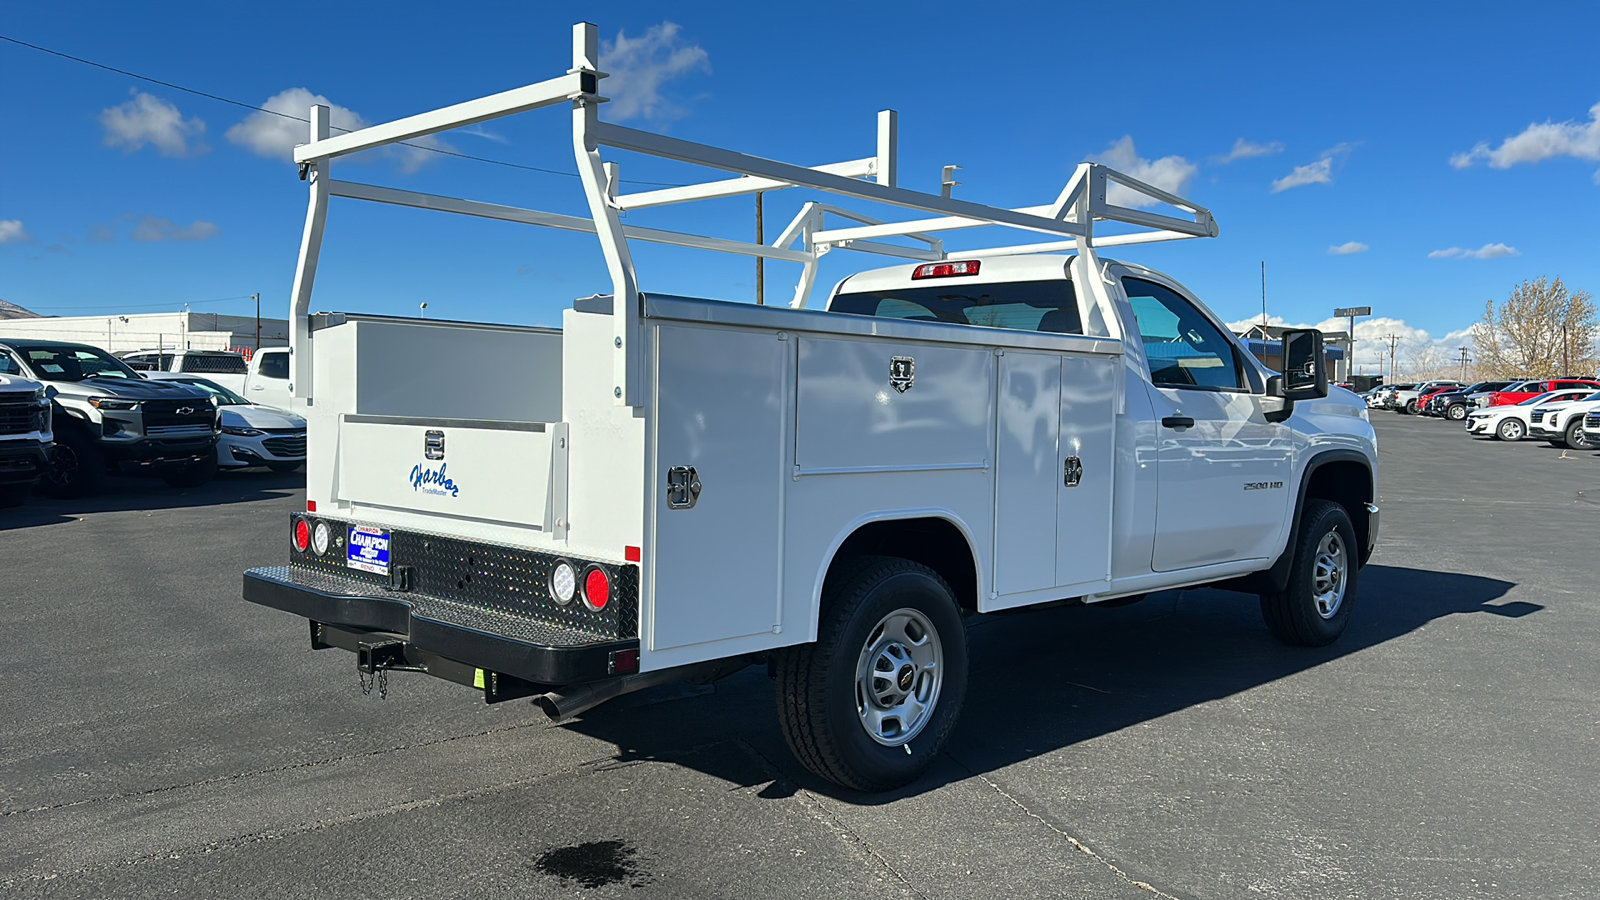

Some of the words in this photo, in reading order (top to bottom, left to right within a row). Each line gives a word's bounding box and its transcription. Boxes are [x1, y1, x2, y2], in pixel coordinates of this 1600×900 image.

[409, 462, 459, 497] Harbor
[1243, 482, 1269, 490] 2500
[1270, 481, 1283, 489] HD
[350, 530, 388, 551] CHAMPION
[360, 563, 374, 571] RENO
